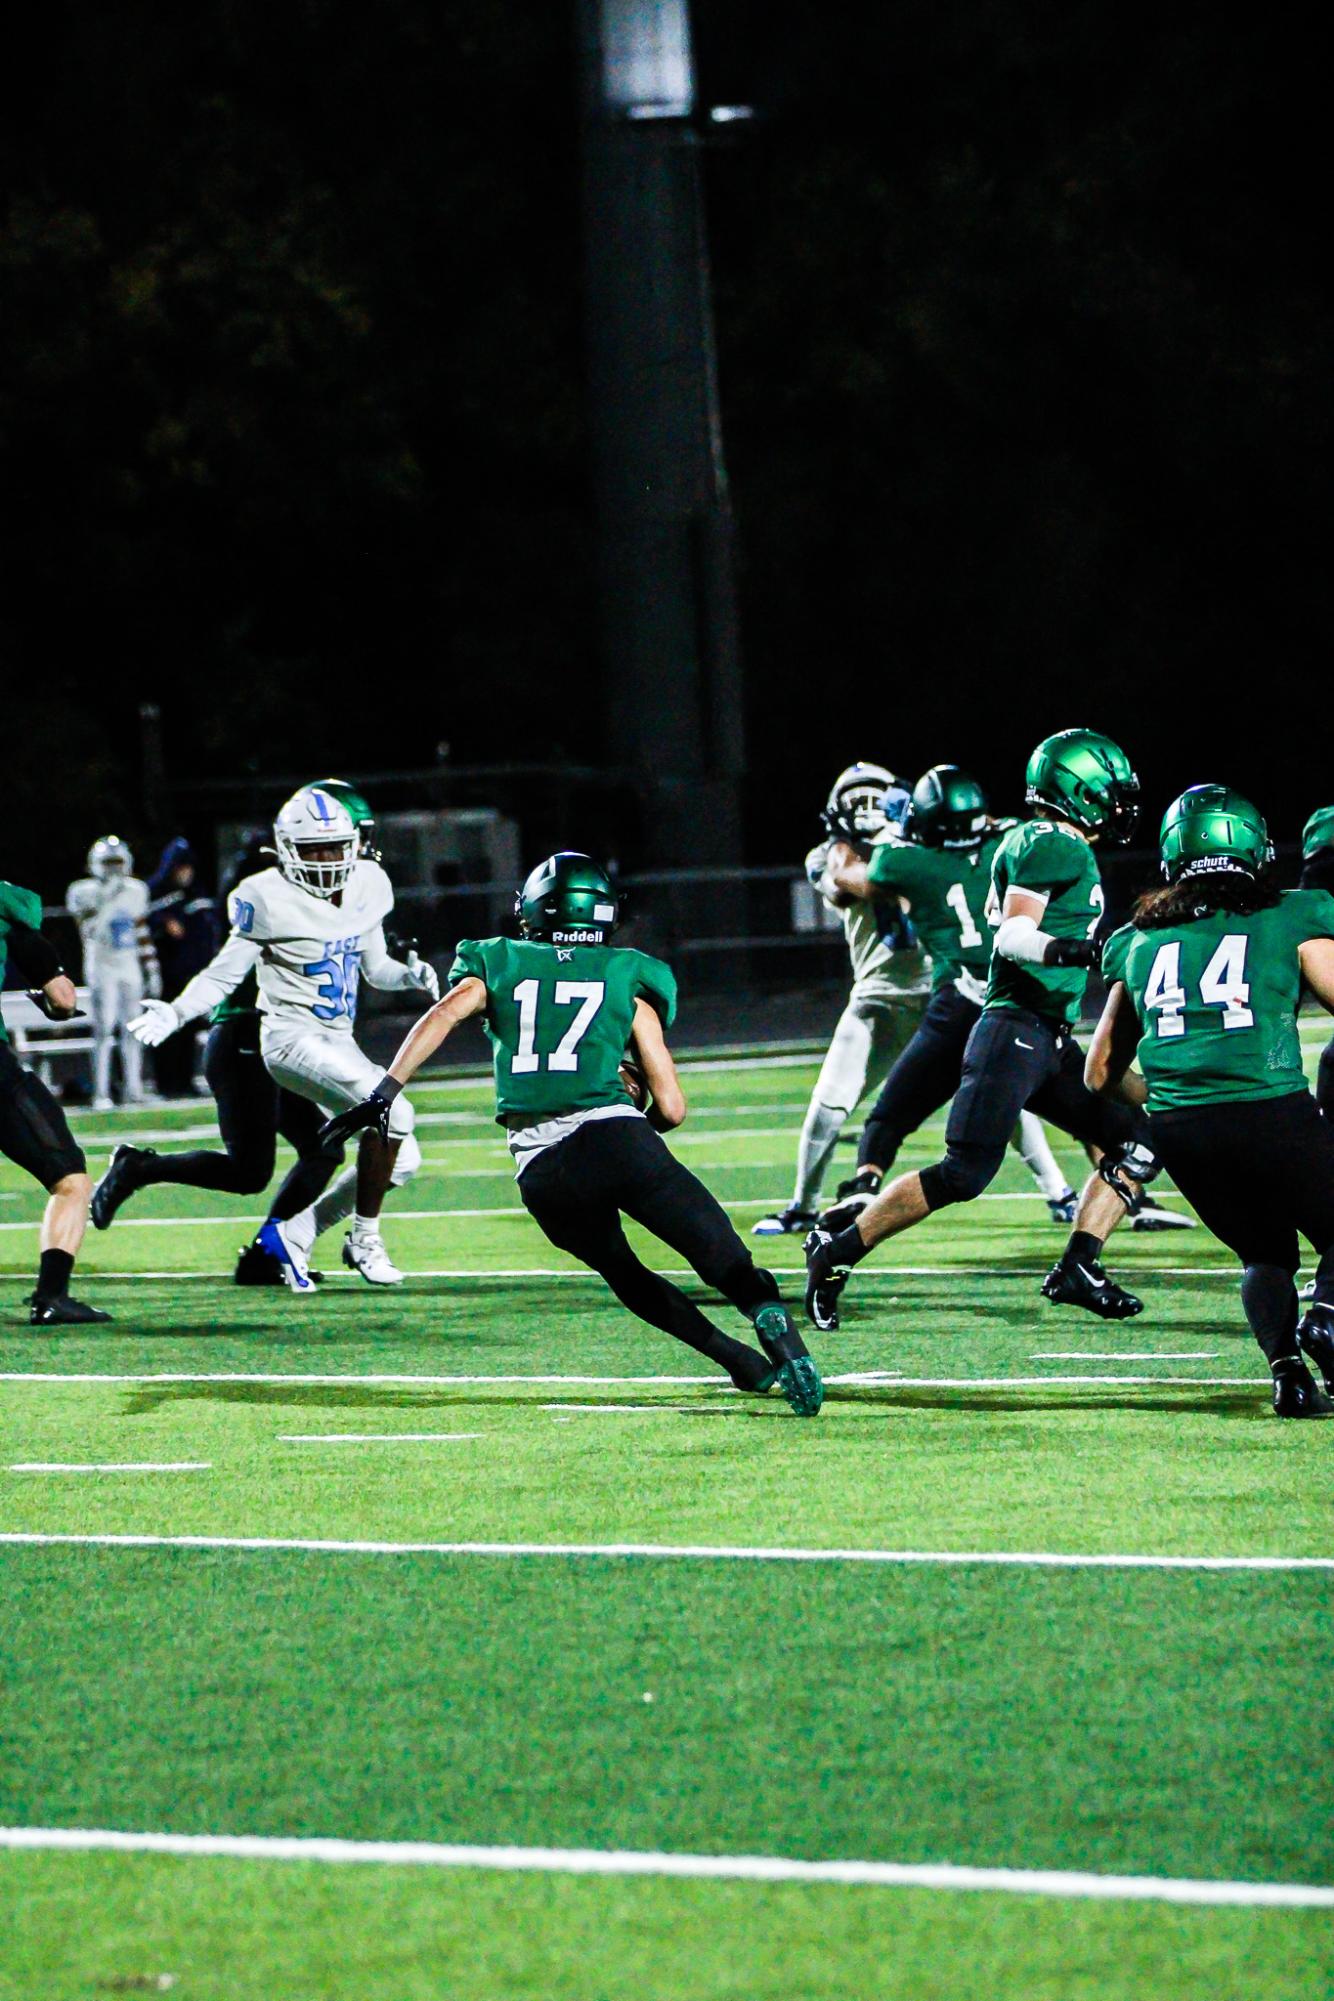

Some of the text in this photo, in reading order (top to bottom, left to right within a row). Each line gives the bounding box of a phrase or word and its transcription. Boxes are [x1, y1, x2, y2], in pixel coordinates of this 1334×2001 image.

[1190, 856, 1229, 869] schutt
[552, 930, 604, 942] Riddell
[303, 952, 361, 1021] 30
[1143, 934, 1255, 1038] 44
[511, 978, 605, 1074] 17
